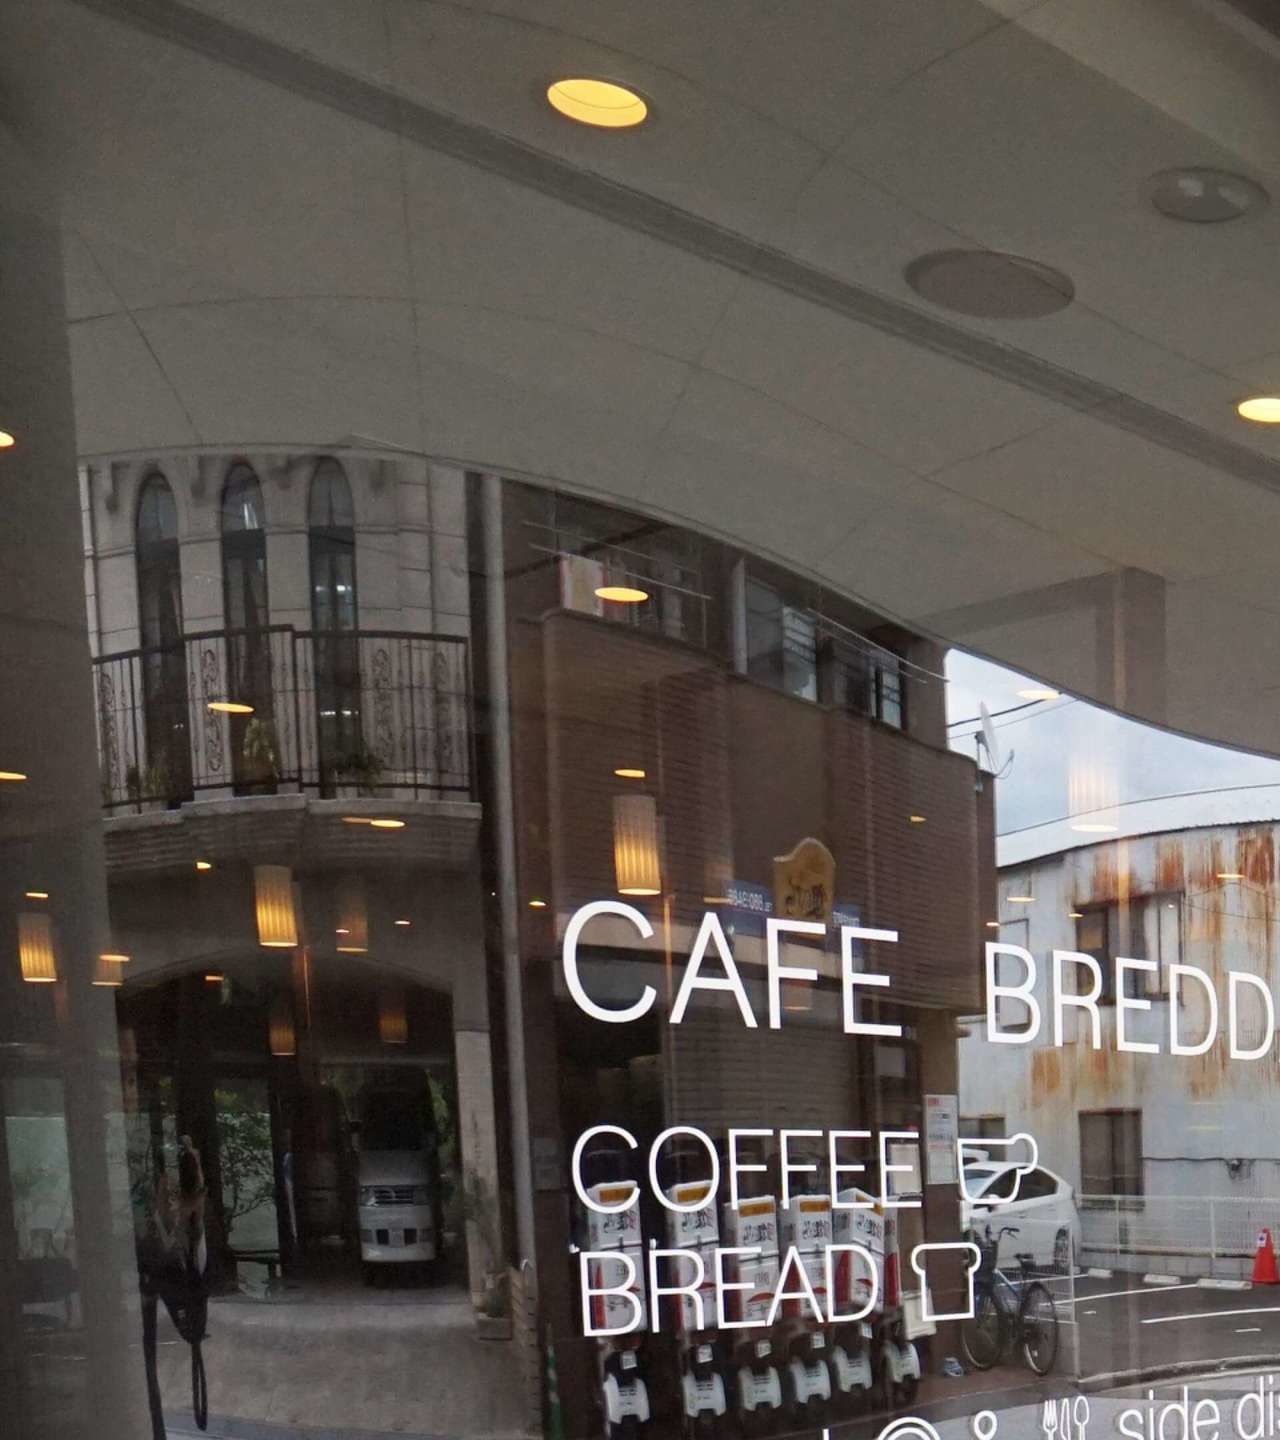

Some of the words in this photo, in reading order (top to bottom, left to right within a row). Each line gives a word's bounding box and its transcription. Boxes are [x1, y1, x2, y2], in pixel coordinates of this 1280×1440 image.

[563, 901, 902, 1036] CAFE
[572, 1125, 922, 1214] COFFEE
[580, 1244, 879, 1336] BREAD
